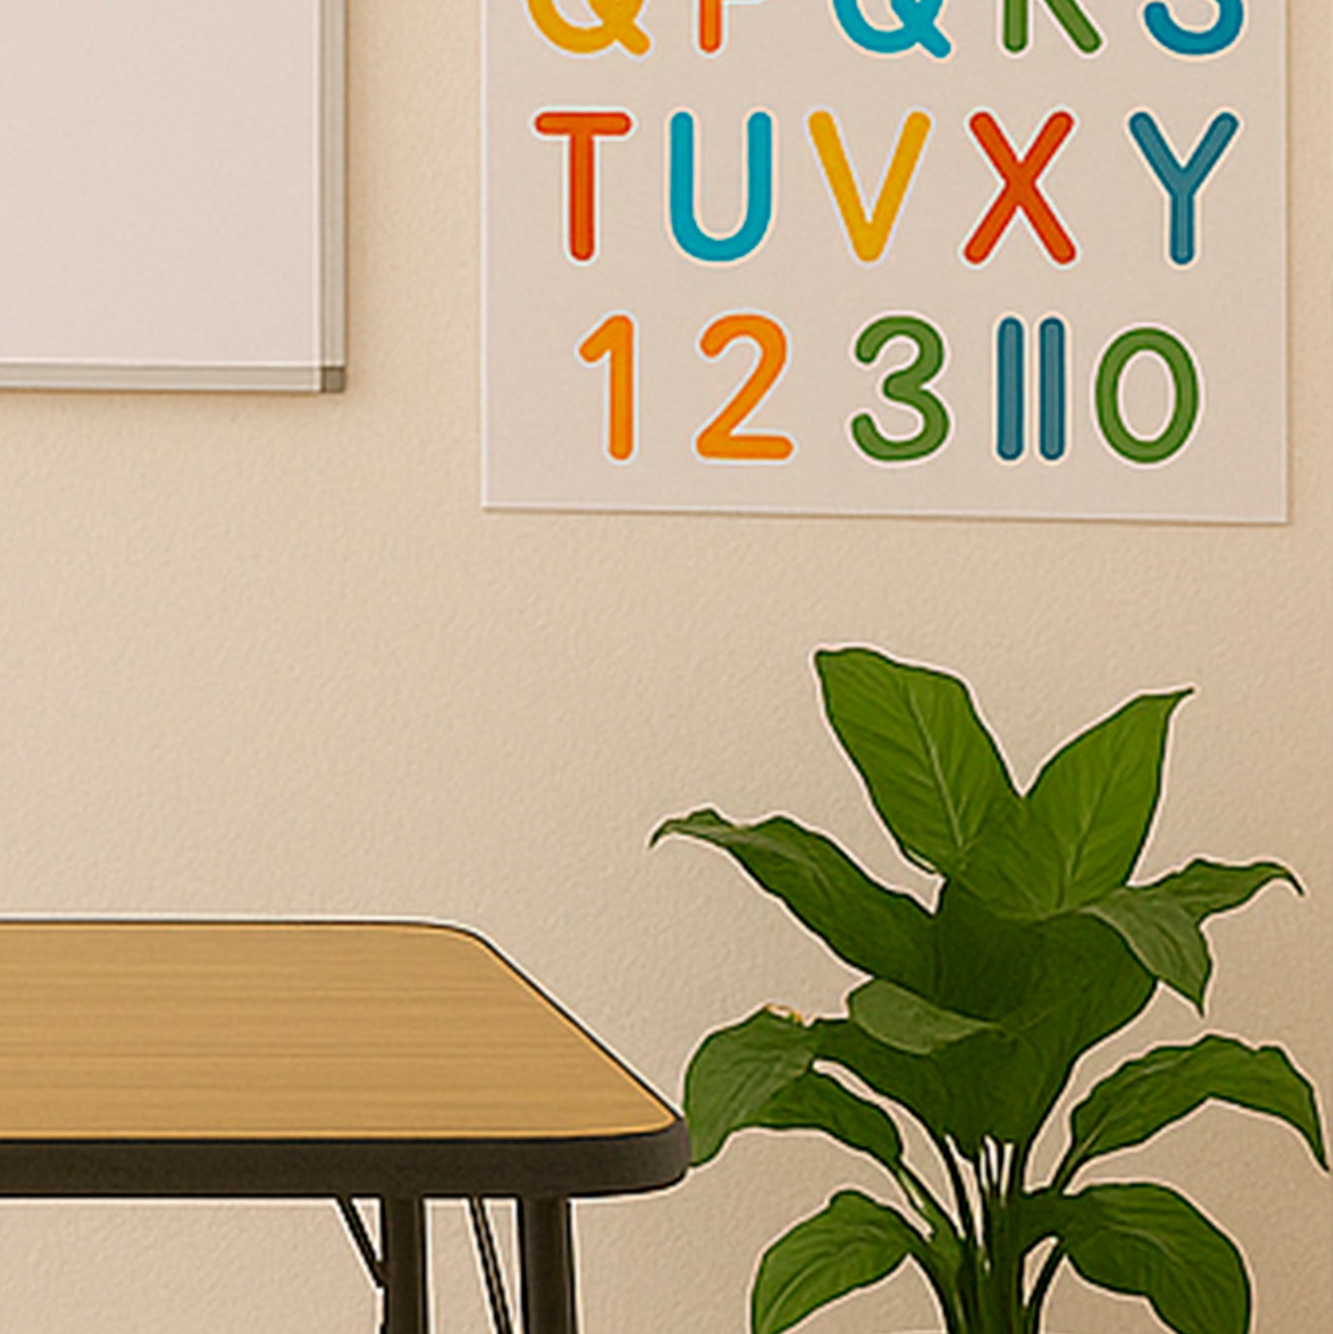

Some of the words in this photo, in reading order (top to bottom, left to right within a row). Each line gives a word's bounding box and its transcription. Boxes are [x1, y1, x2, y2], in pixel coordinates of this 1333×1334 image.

[535, 112, 632, 261] T
[671, 112, 771, 261] U
[808, 111, 931, 262] V
[963, 111, 1076, 264] X
[1130, 113, 1238, 264] Y
[579, 315, 634, 460] 1
[696, 314, 794, 460] 2
[852, 317, 949, 461] 3
